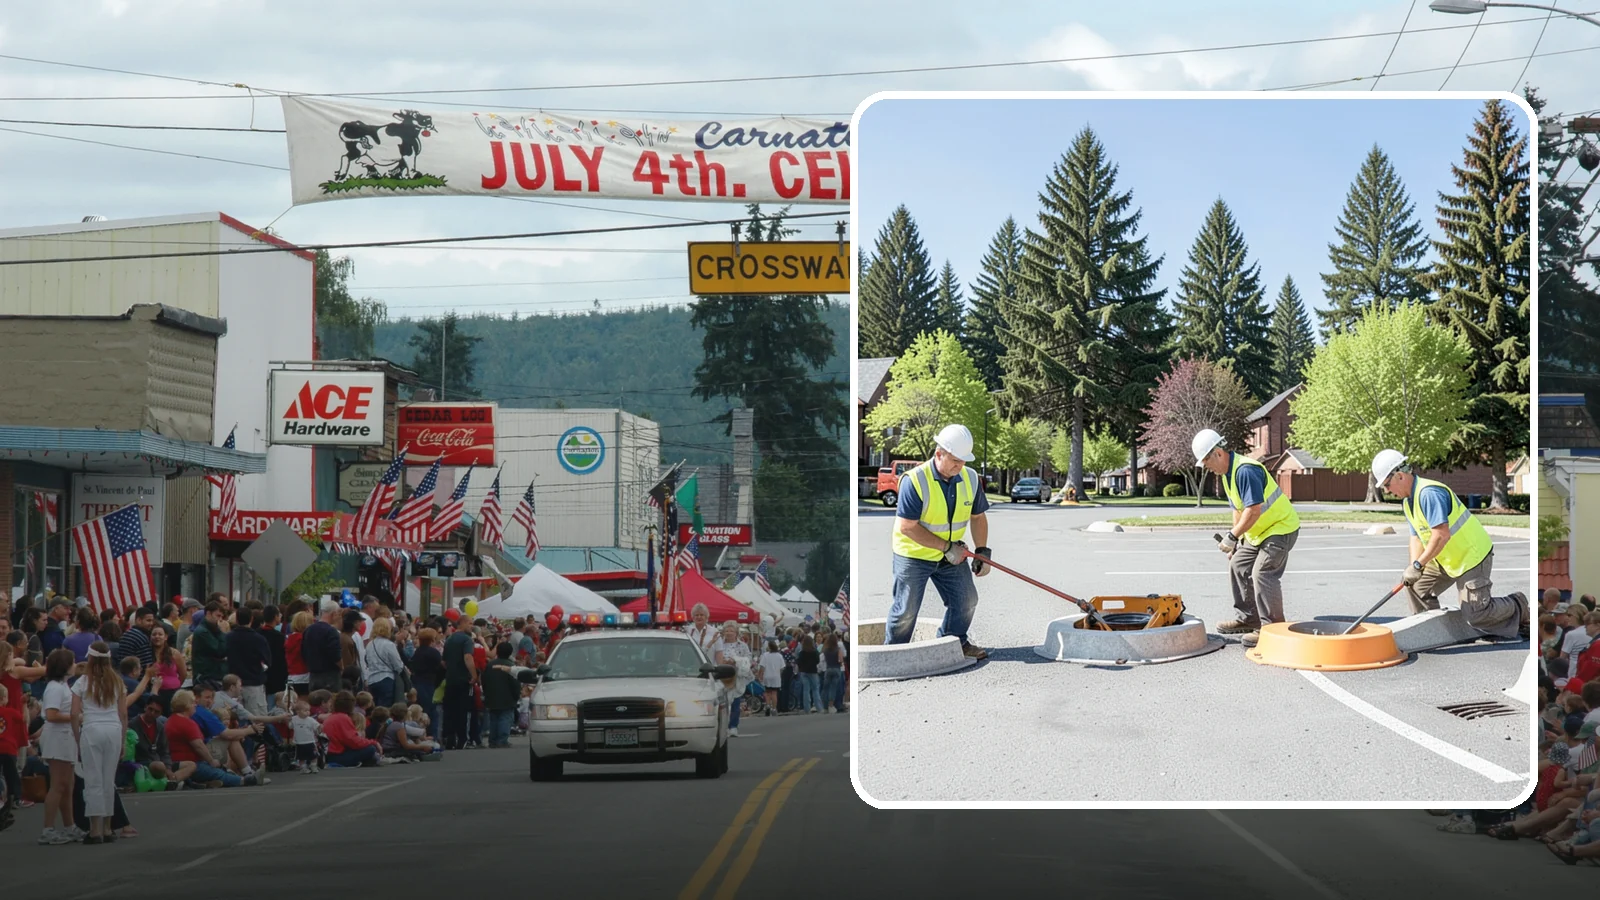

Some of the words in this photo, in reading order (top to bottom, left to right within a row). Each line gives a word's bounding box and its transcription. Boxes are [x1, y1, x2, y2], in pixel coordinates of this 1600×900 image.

[695, 121, 850, 149] Carnat
[481, 141, 605, 192] JULY
[632, 150, 746, 198] 4th.
[697, 254, 850, 280] CROSSWA
[283, 380, 373, 420] ACE
[406, 409, 453, 422] CEDAR
[461, 409, 485, 421] LOG
[284, 421, 371, 436] Hardware
[416, 428, 477, 447] Coca-Cola
[354, 467, 386, 479] Simpl
[83, 485, 94, 494] St.
[96, 485, 124, 495] Vincent
[126, 486, 136, 495] de
[138, 486, 155, 495] Paul
[81, 503, 154, 522] THRT
[212, 516, 330, 535] HARDARE
[688, 526, 741, 535] CRNATION
[699, 535, 730, 543] GLASS
